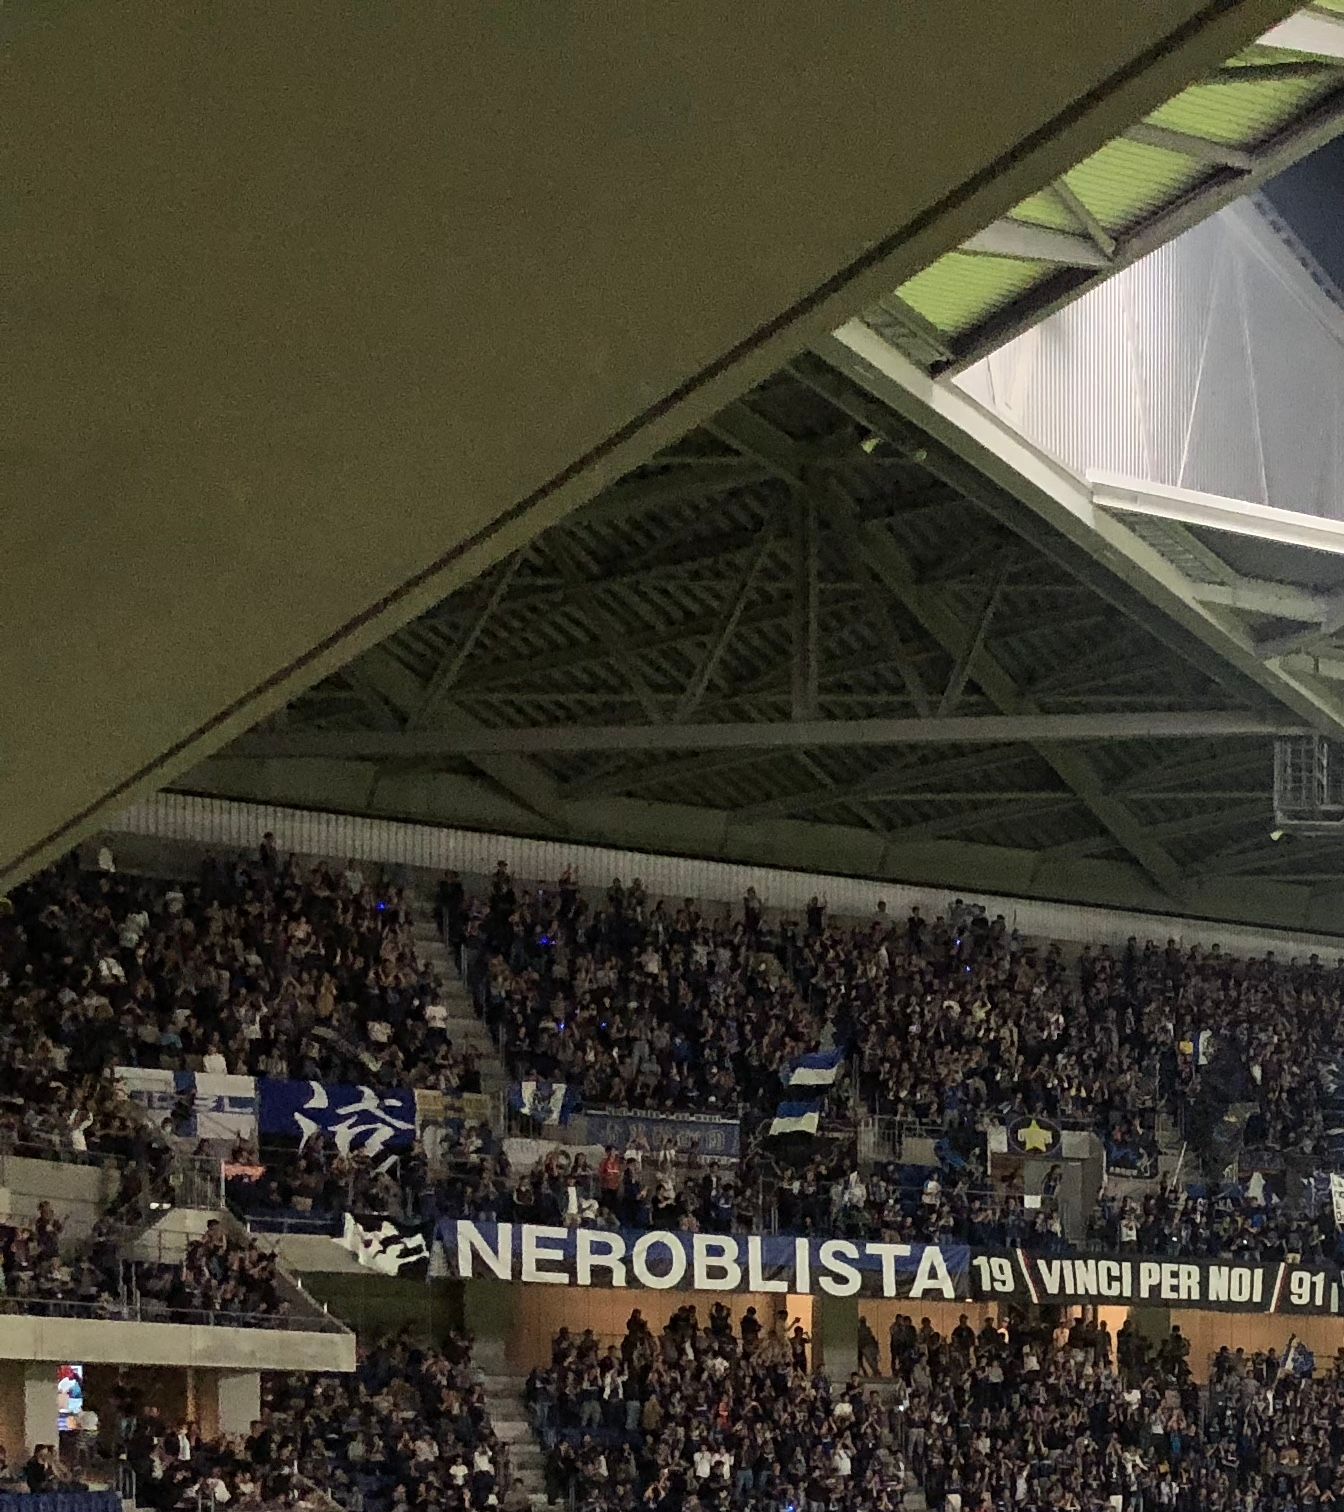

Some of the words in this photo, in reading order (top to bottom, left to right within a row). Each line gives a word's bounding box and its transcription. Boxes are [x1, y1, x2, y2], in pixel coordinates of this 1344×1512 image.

[456, 1219, 956, 1298] NEROBLISTA
[972, 1256, 1014, 1293] 19
[1037, 1258, 1132, 1298] VINCI
[1140, 1261, 1202, 1301] PER
[1208, 1265, 1264, 1303] NOI
[1290, 1272, 1326, 1306] 91
